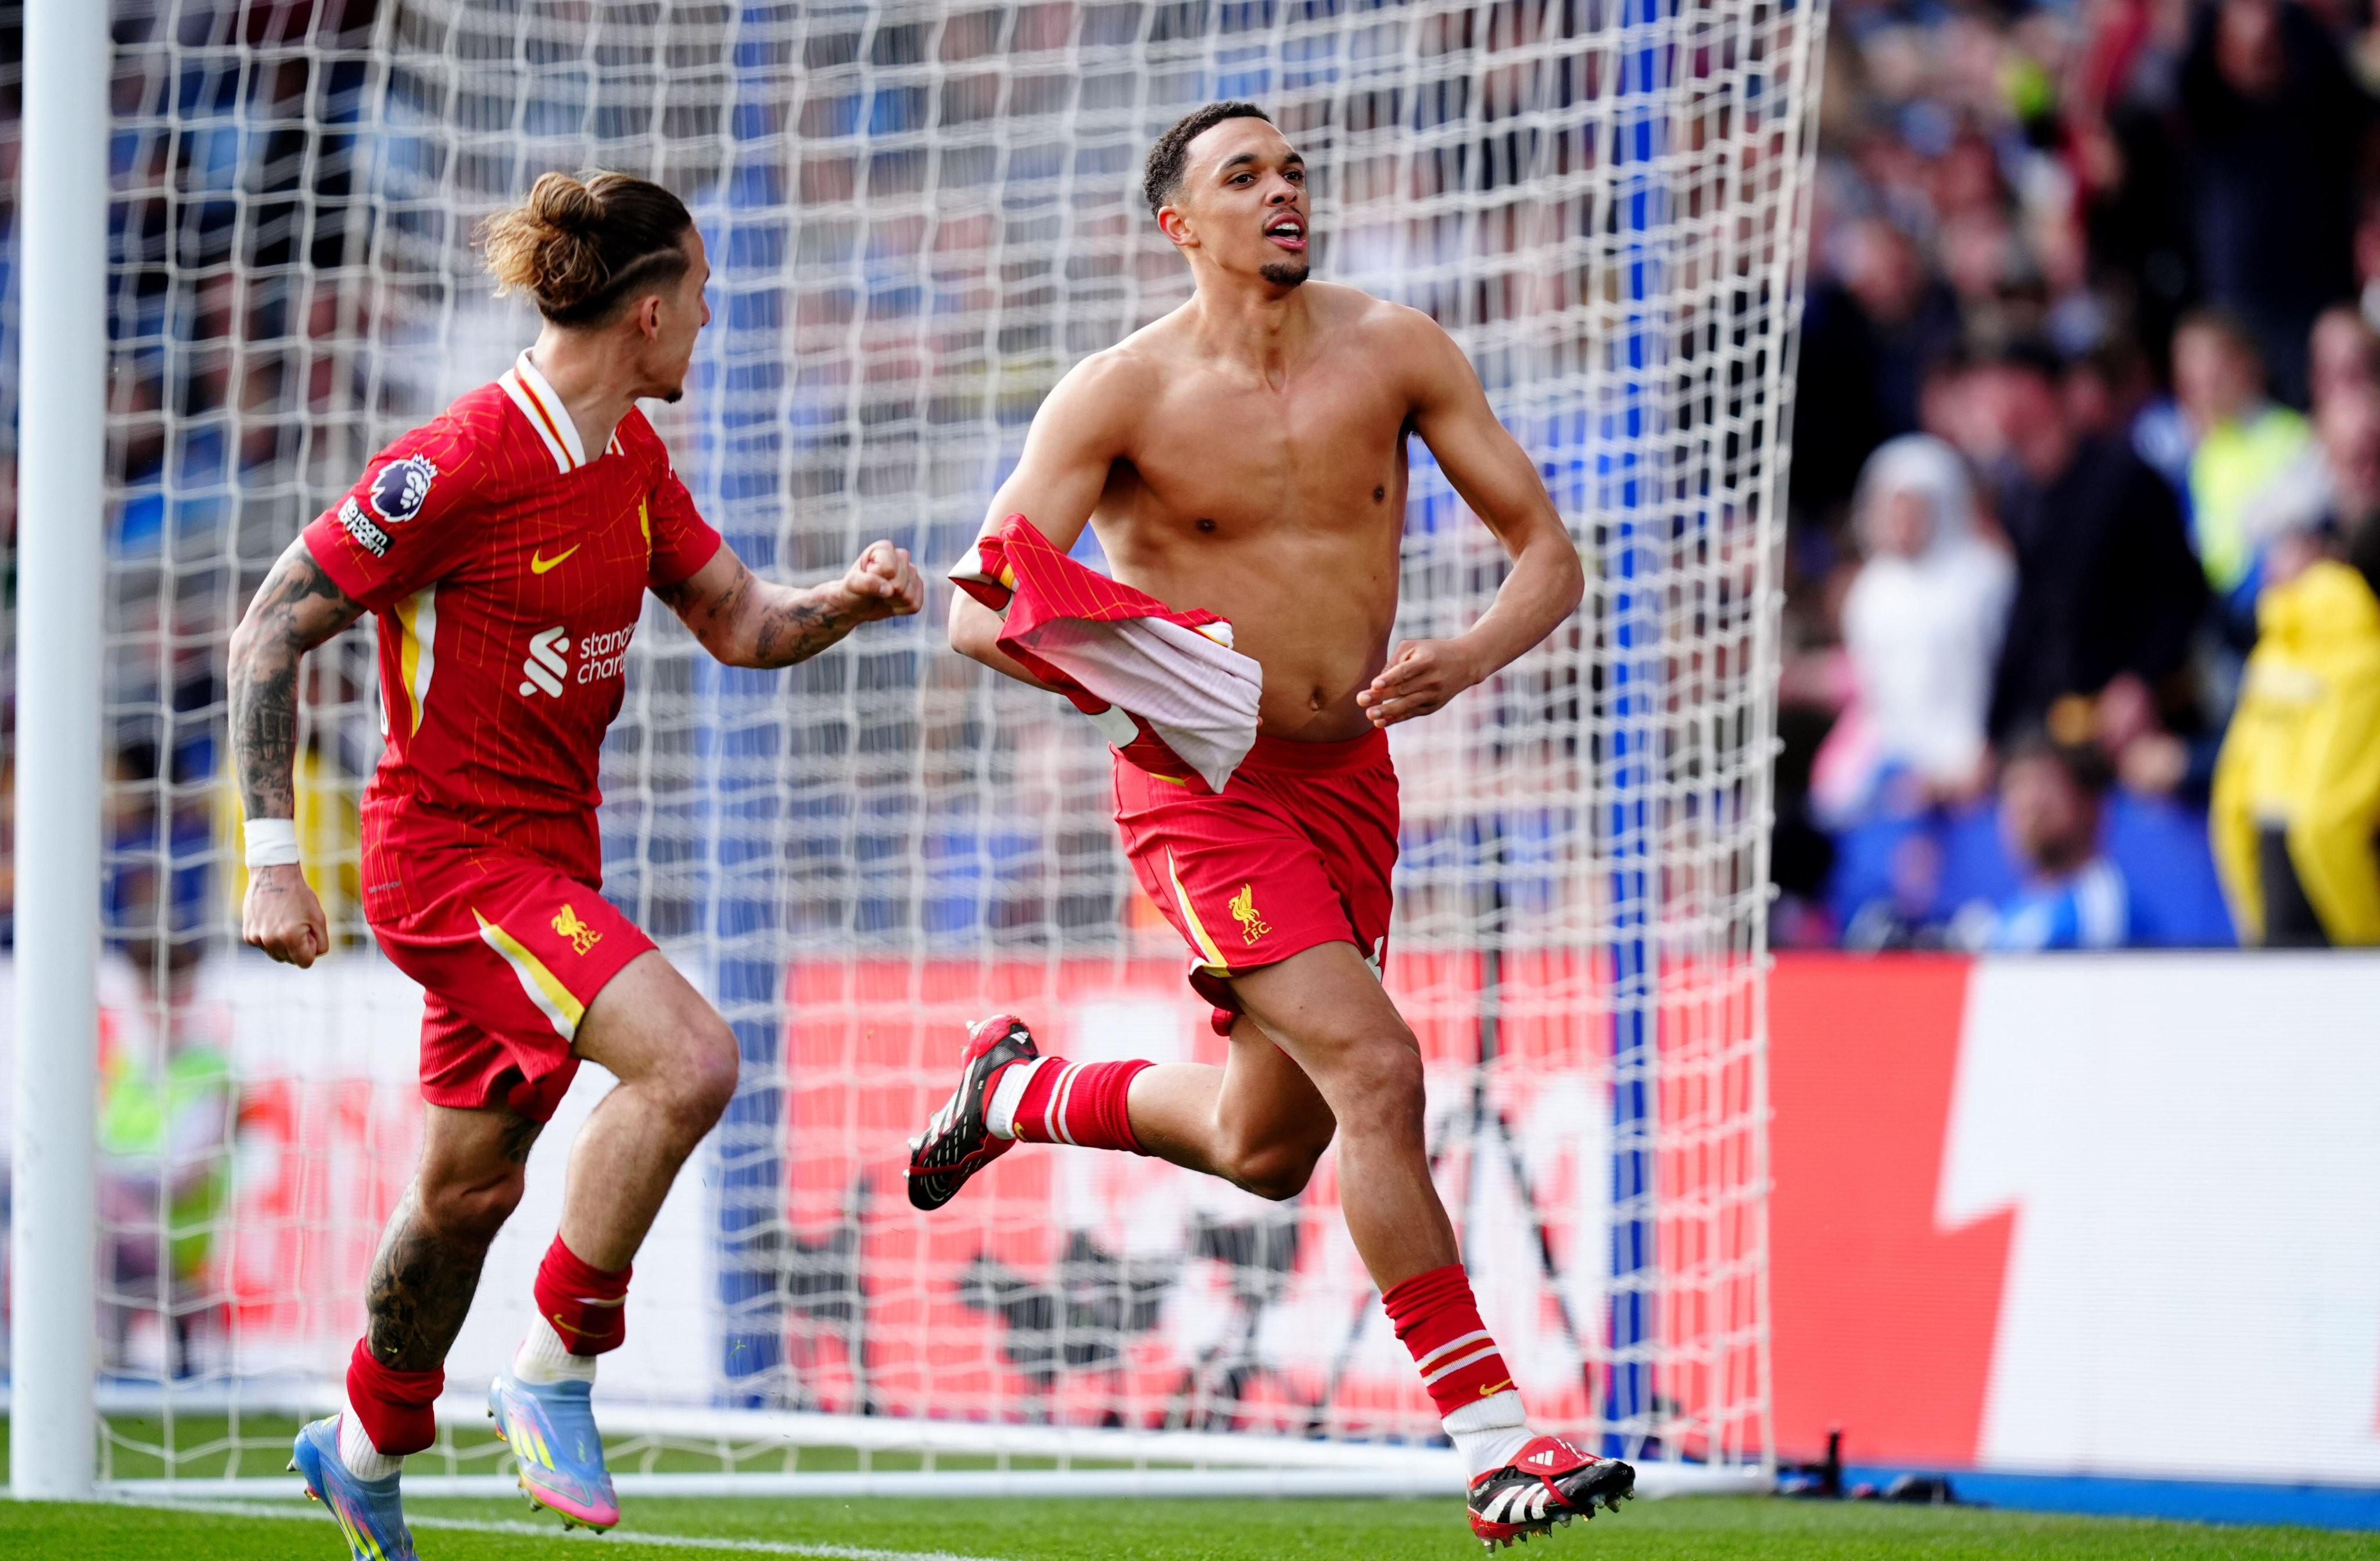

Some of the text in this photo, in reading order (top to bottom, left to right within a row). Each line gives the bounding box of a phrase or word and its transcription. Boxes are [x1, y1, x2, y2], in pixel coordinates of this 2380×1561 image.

[347, 521, 385, 558] racism
[355, 512, 388, 547] room
[578, 650, 626, 684] chart
